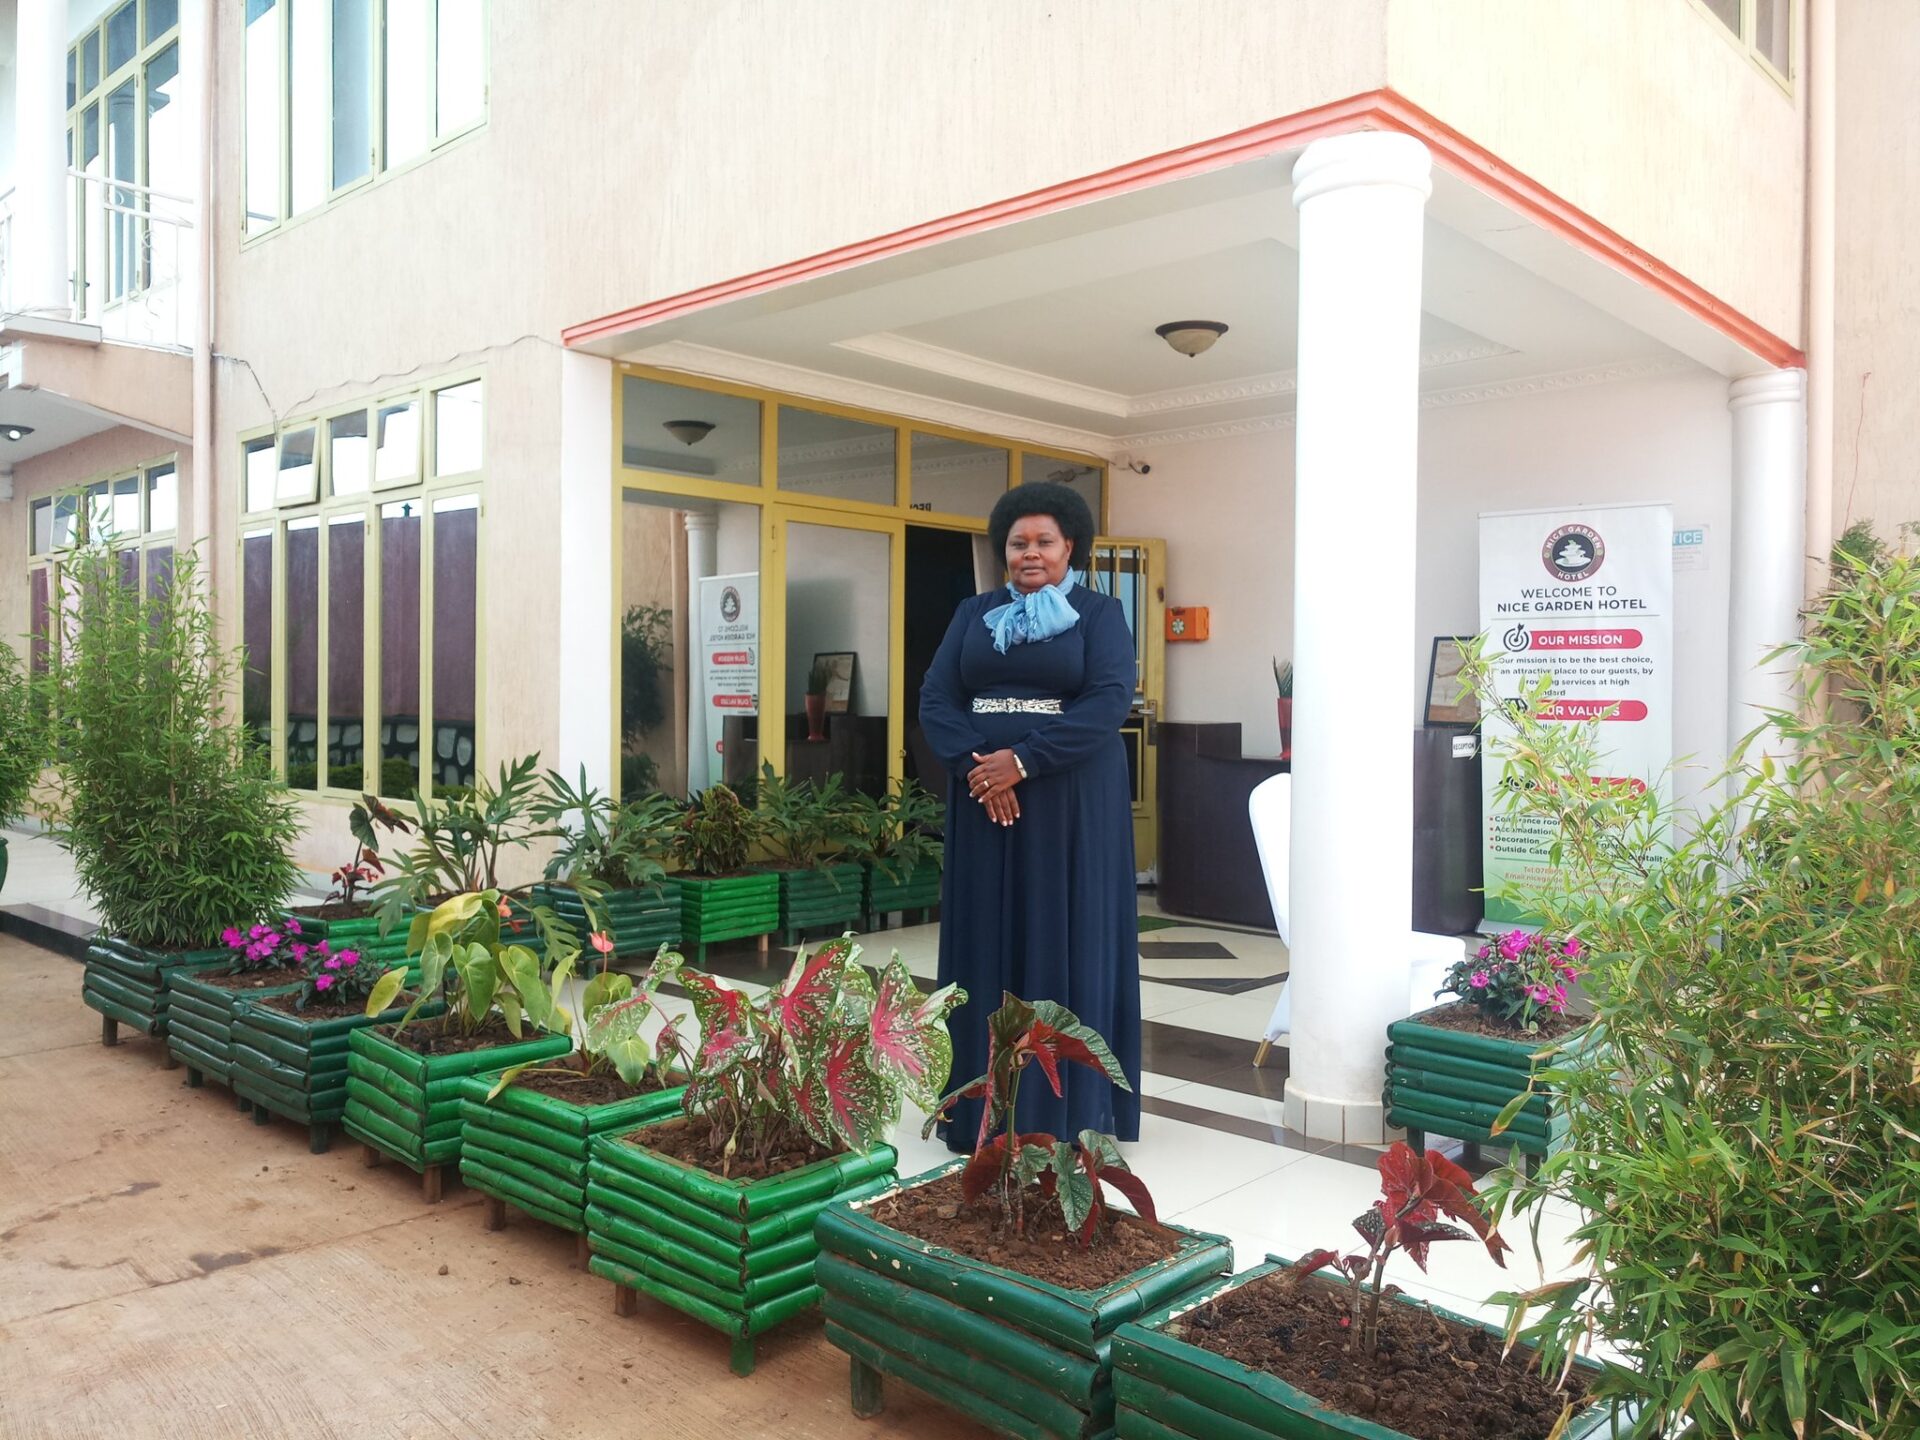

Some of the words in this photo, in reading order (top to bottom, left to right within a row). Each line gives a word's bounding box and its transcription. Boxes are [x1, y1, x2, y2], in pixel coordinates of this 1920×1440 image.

[1546, 528, 1565, 549] NICE
[1567, 525, 1602, 549] GARDEN
[1672, 533, 1702, 544] TICE
[1557, 571, 1589, 581] HOTEL
[1520, 586, 1592, 599] WELCOME
[1597, 585, 1617, 597] TO
[1497, 602, 1530, 613] NICE
[1534, 600, 1593, 612] GARDEN
[1598, 599, 1647, 611] HOTEL
[1538, 635, 1565, 645] OUR
[1568, 634, 1623, 645] MISSION
[1516, 656, 1548, 664] mission
[1549, 656, 1557, 664] is
[1558, 656, 1568, 664] to
[1569, 656, 1581, 664] be
[1621, 655, 1653, 664] choice,
[1554, 667, 1577, 676] place
[1579, 667, 1588, 675] to
[1608, 668, 1640, 677] guests,
[1642, 666, 1654, 676] by
[1598, 678, 1608, 686] at
[1609, 678, 1630, 687] high
[1495, 835, 1540, 845] Decoration
[1494, 845, 1527, 854] Outside
